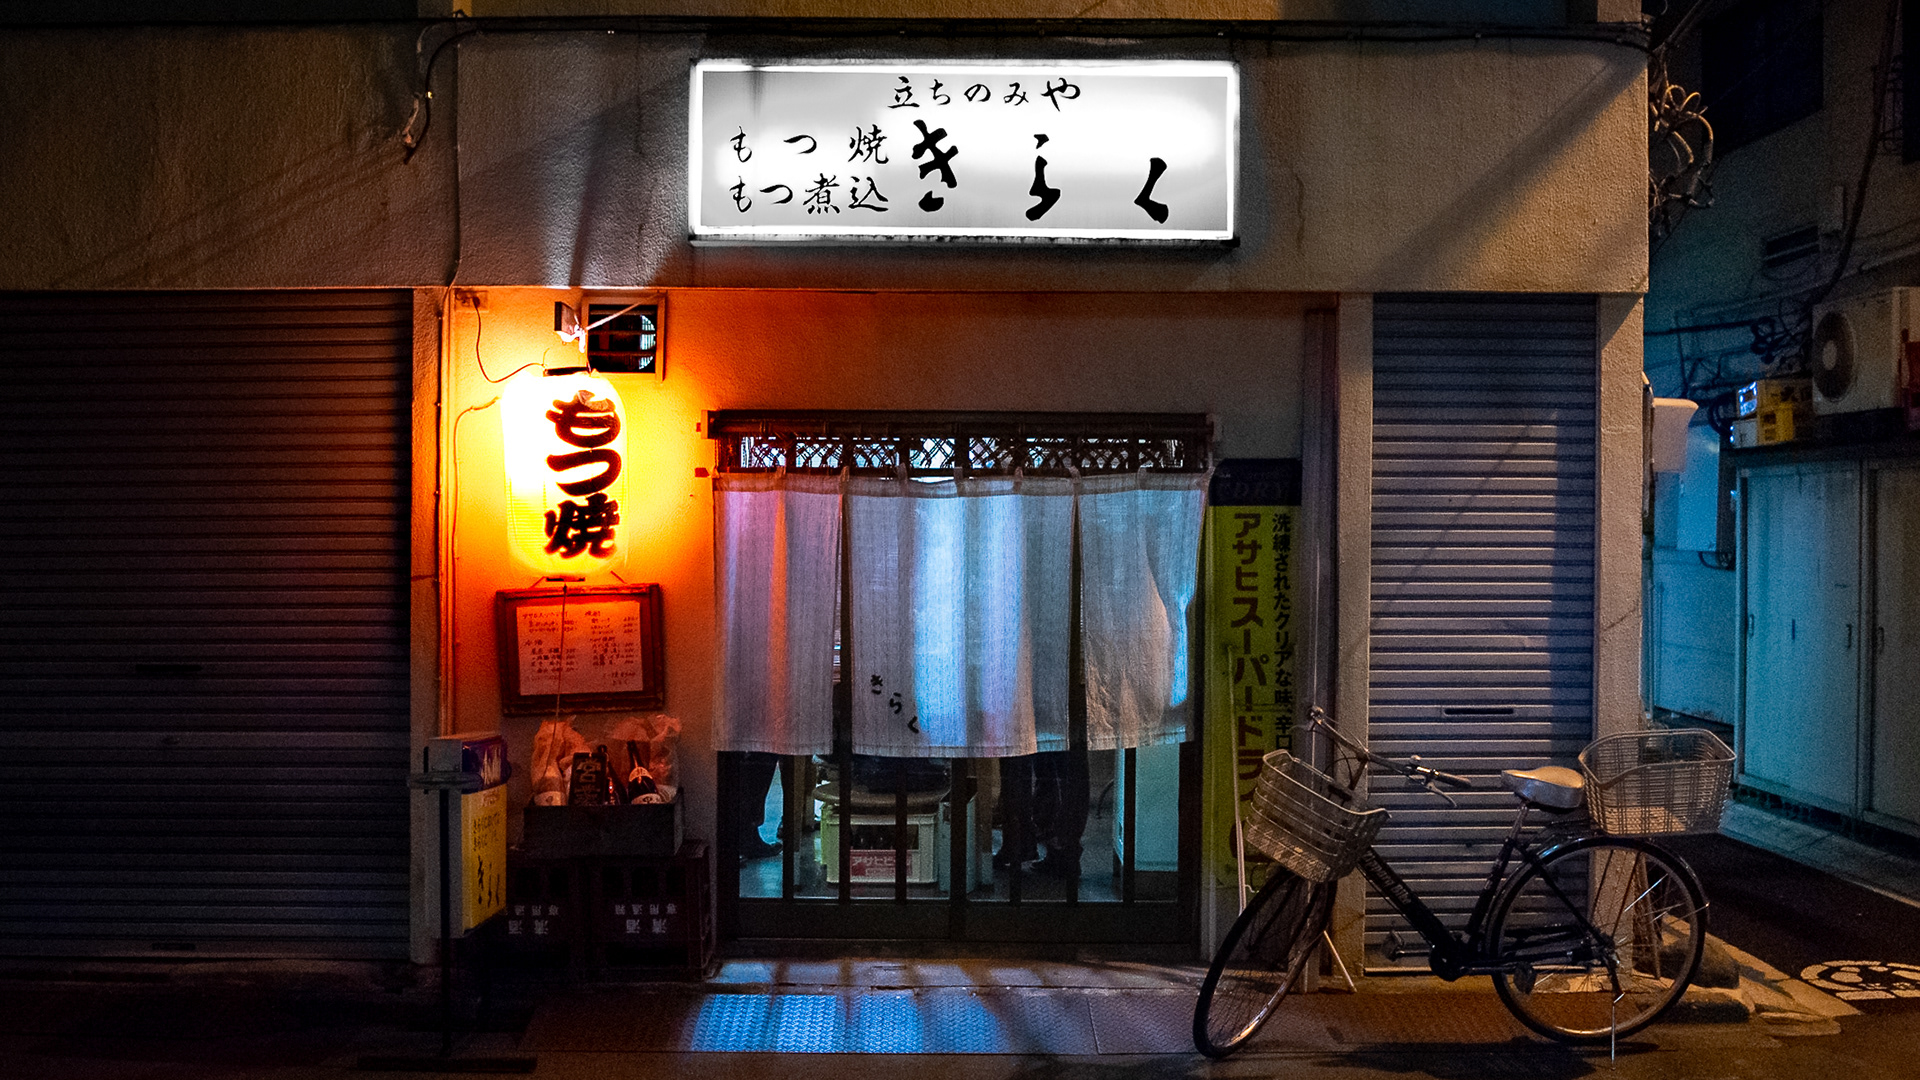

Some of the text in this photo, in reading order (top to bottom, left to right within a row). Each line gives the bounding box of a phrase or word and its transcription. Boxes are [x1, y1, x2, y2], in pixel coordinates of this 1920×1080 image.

[887, 76, 1081, 112] 立ちのみや
[729, 125, 890, 164] もつ焼
[911, 119, 1170, 224] きらく
[729, 174, 890, 215] もつ煮込
[545, 389, 622, 559] もつ焼
[1231, 512, 1268, 802] アサヒスーパードラ
[870, 674, 919, 734] きらく
[477, 855, 501, 908] きらく
